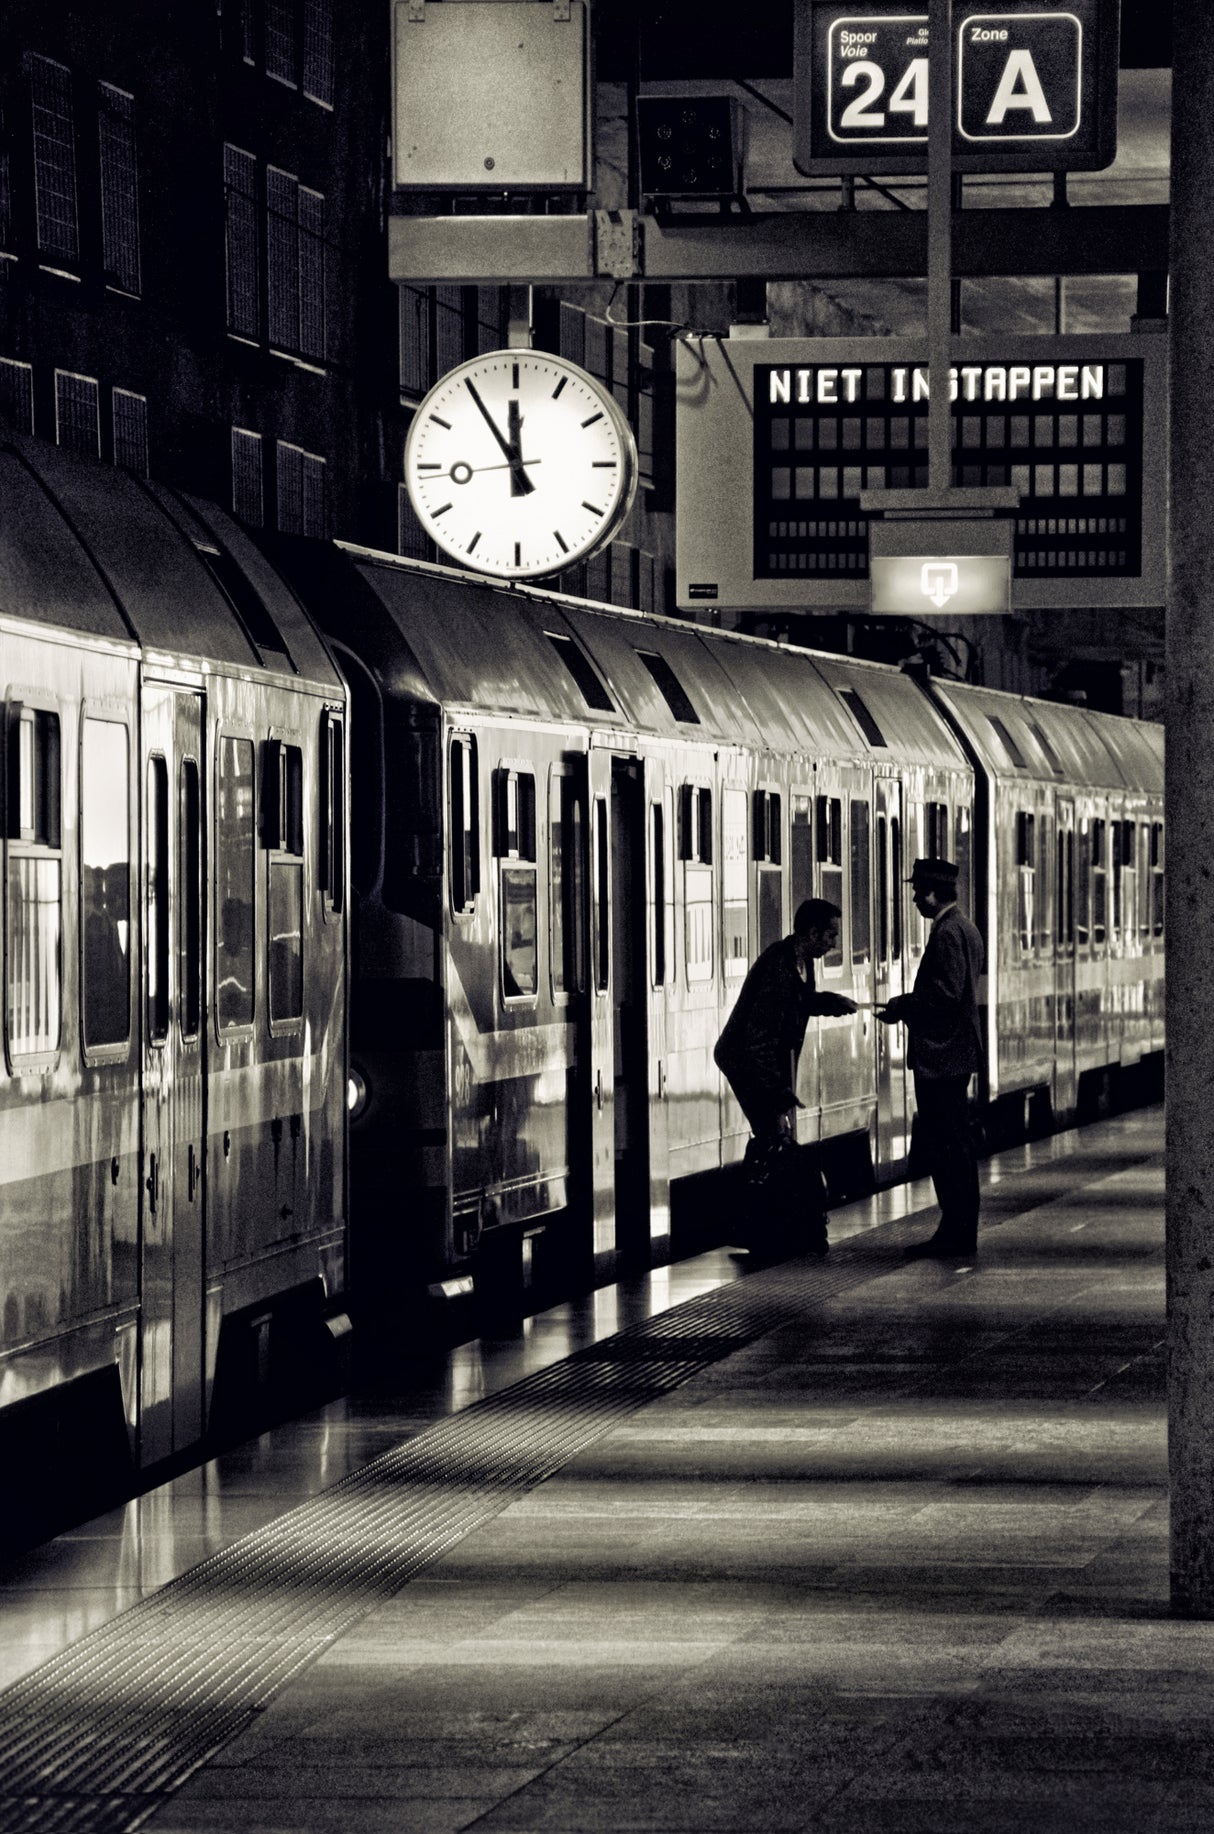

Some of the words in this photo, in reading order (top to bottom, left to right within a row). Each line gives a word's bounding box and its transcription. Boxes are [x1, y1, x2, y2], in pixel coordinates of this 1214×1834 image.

[840, 30, 878, 45] Spoor
[971, 27, 1009, 42] Zone
[840, 44, 868, 57] Voie
[840, 57, 929, 127] 24
[986, 49, 1053, 124] A
[769, 369, 862, 403] NIET
